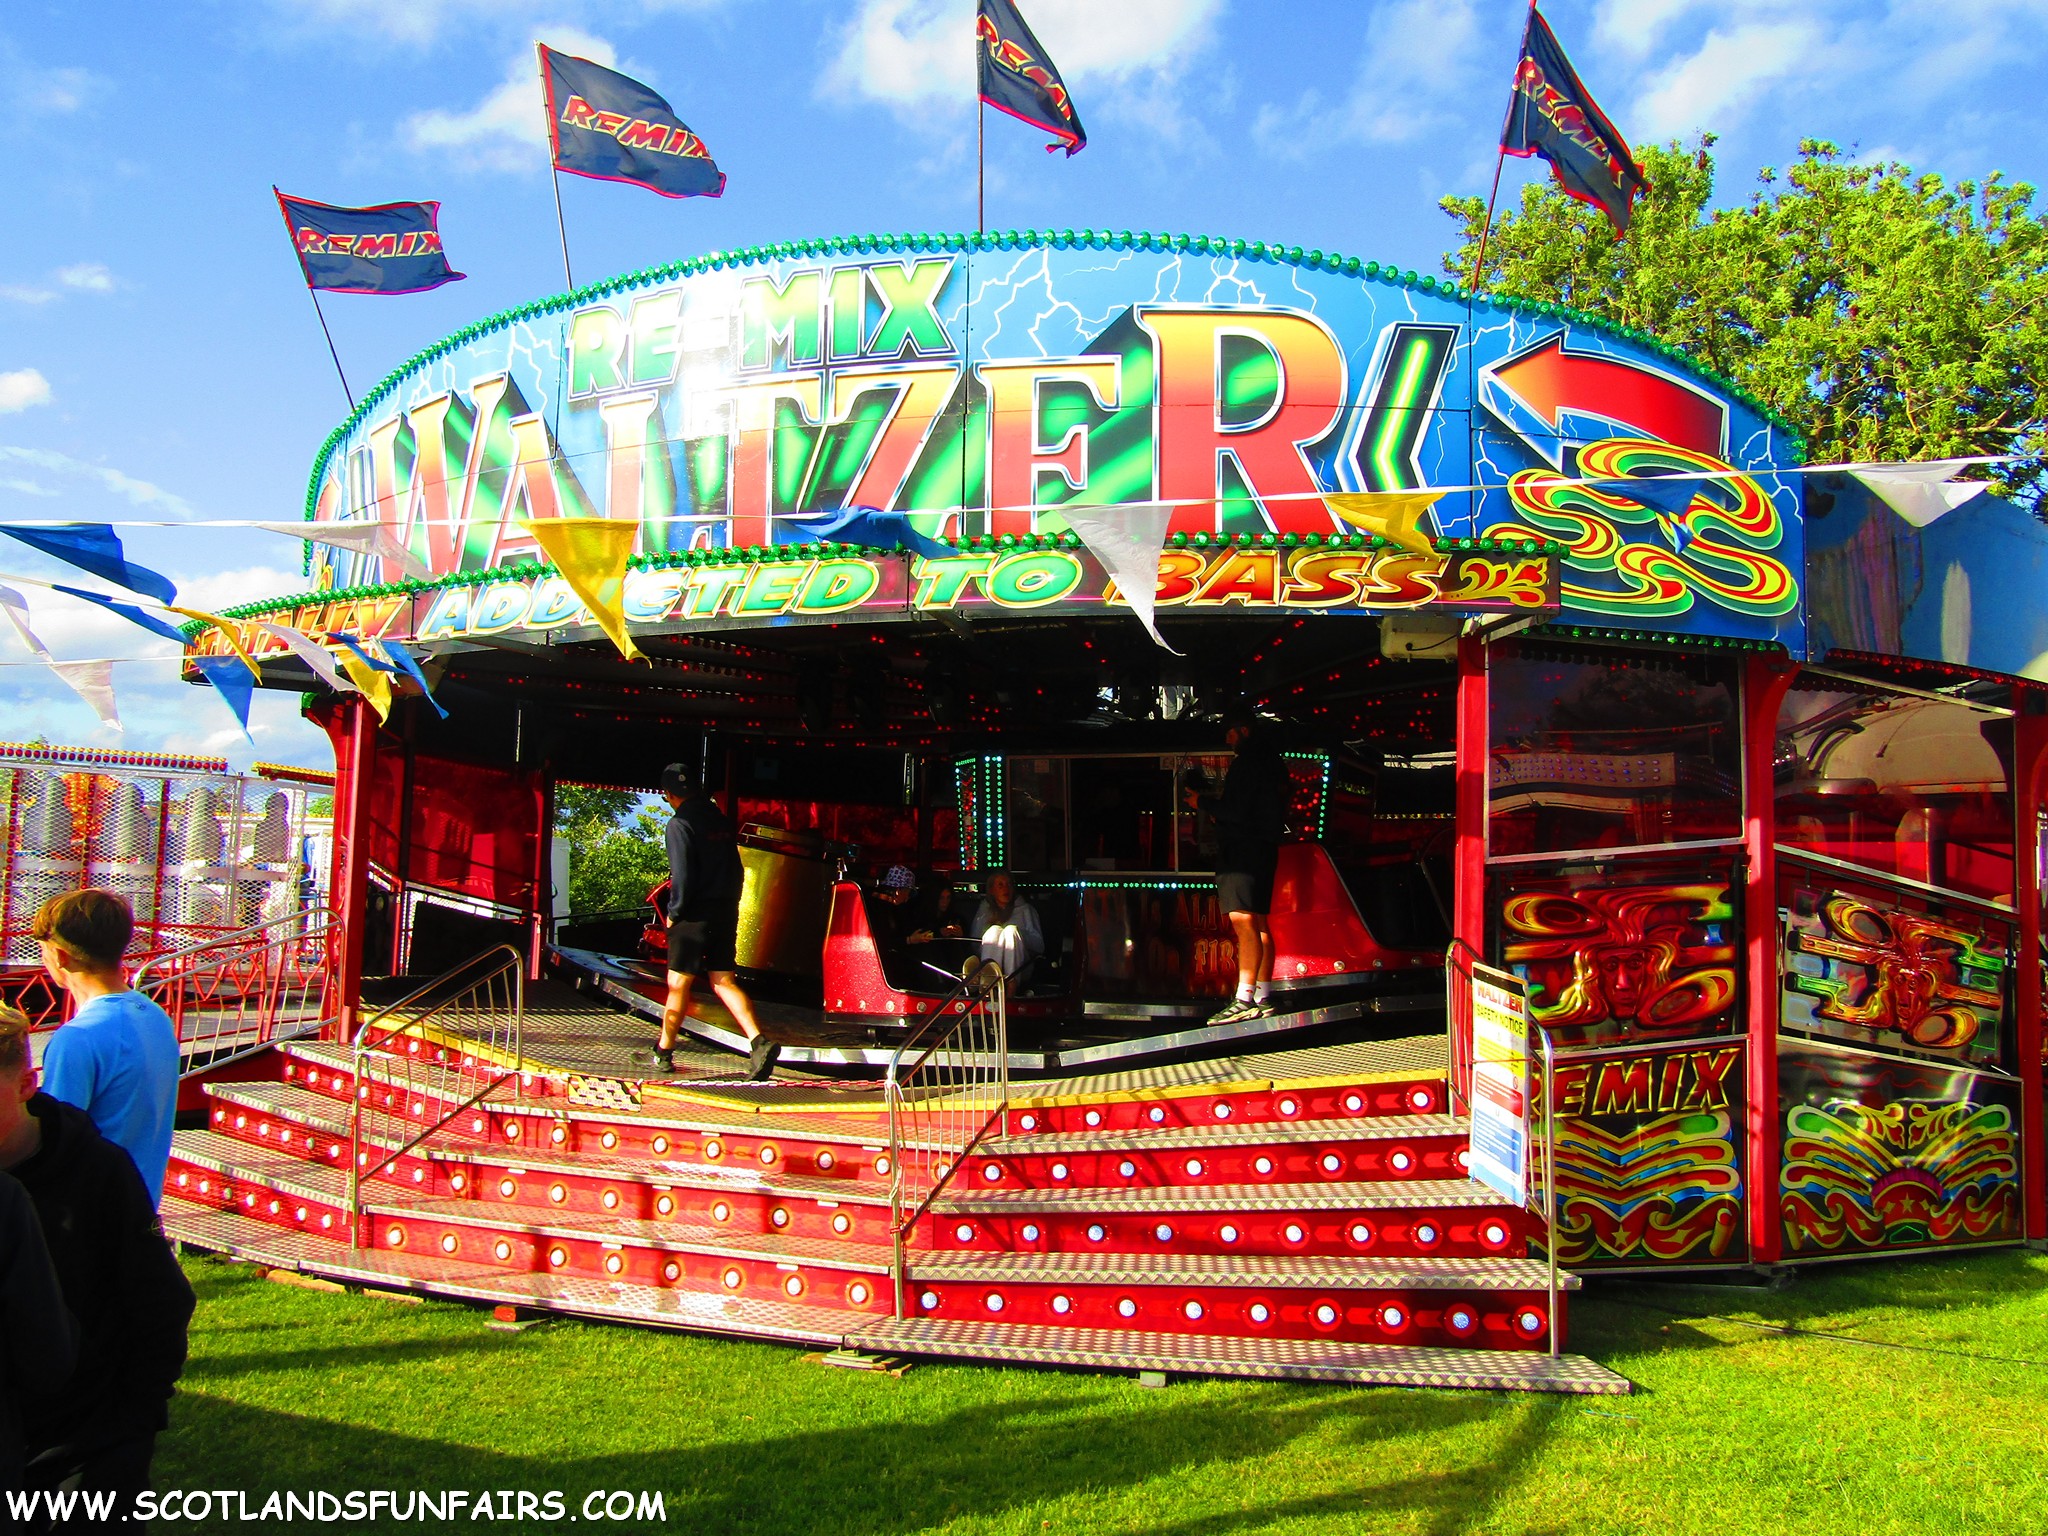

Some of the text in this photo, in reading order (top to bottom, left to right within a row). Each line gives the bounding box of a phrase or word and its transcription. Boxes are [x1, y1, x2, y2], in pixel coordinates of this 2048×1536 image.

[562, 95, 713, 159] REMIX
[298, 227, 442, 259] REMIX
[567, 253, 961, 402] RE-MIX
[368, 302, 1351, 582] WALTZER
[418, 556, 882, 642] ADDCTED
[912, 548, 1085, 612] TO
[1102, 551, 1452, 608] BASS
[1194, 937, 1239, 977] FIR
[1477, 982, 1524, 1014] WALTZER
[1499, 1012, 1524, 1035] NOTICE
[586, 1080, 621, 1090] WARNING
